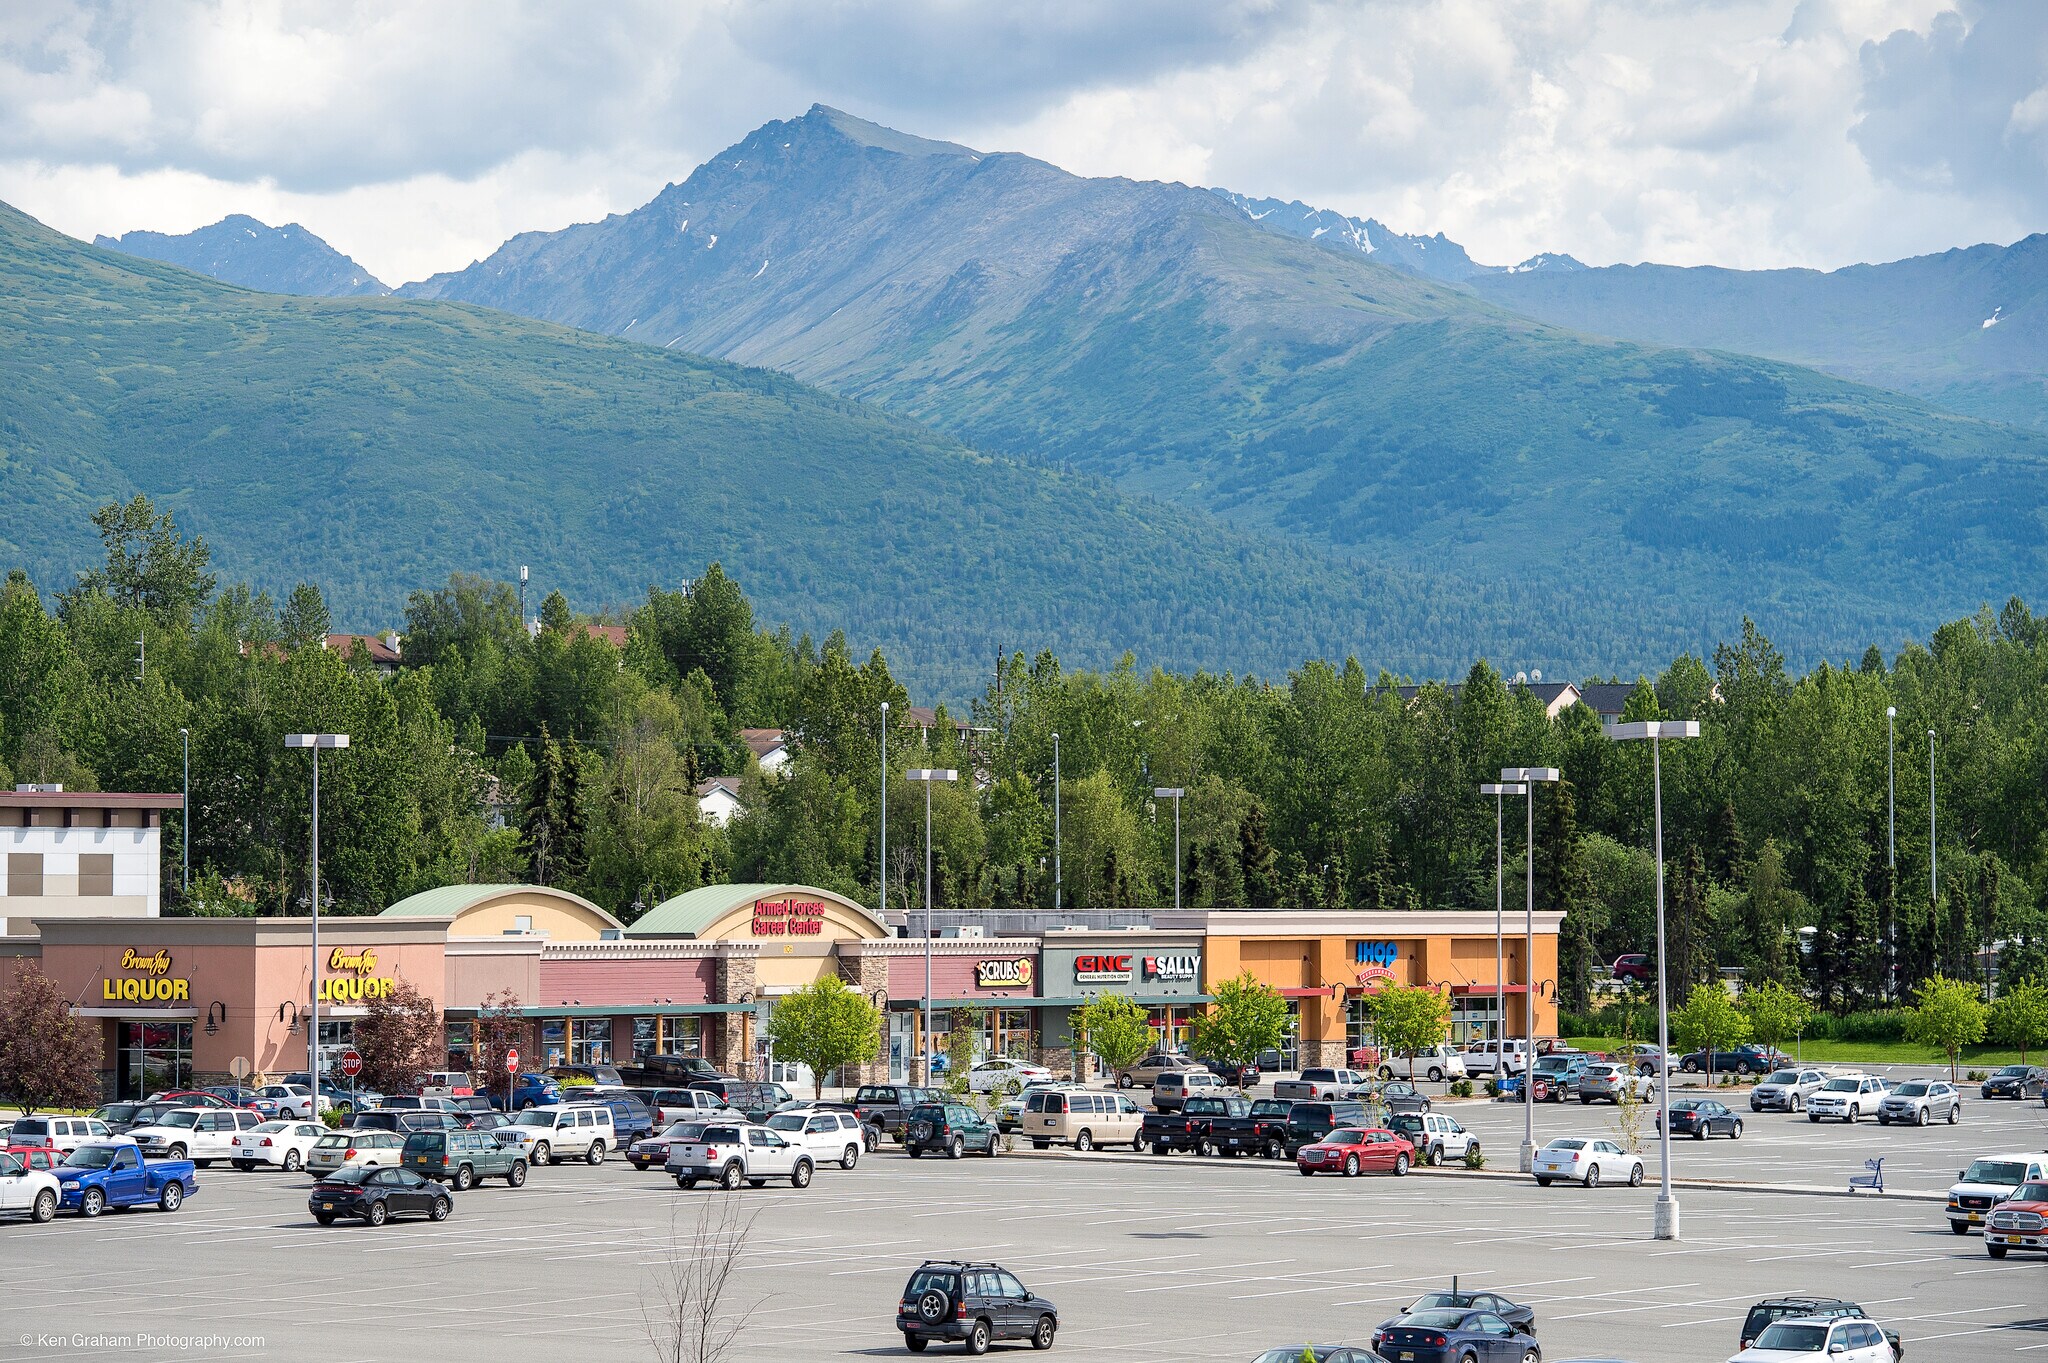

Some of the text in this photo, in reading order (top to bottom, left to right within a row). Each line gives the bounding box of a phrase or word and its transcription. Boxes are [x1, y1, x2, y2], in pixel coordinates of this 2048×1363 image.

[754, 899, 825, 916] Armed Forces
[752, 918, 823, 935] Career Center
[1076, 955, 1133, 972] GNC
[1357, 942, 1398, 968] IHOP
[979, 960, 1020, 981] SCRUBS
[1156, 956, 1202, 975] SALLY
[103, 978, 189, 1004] LIQUOR
[343, 1058, 361, 1069] STOP
